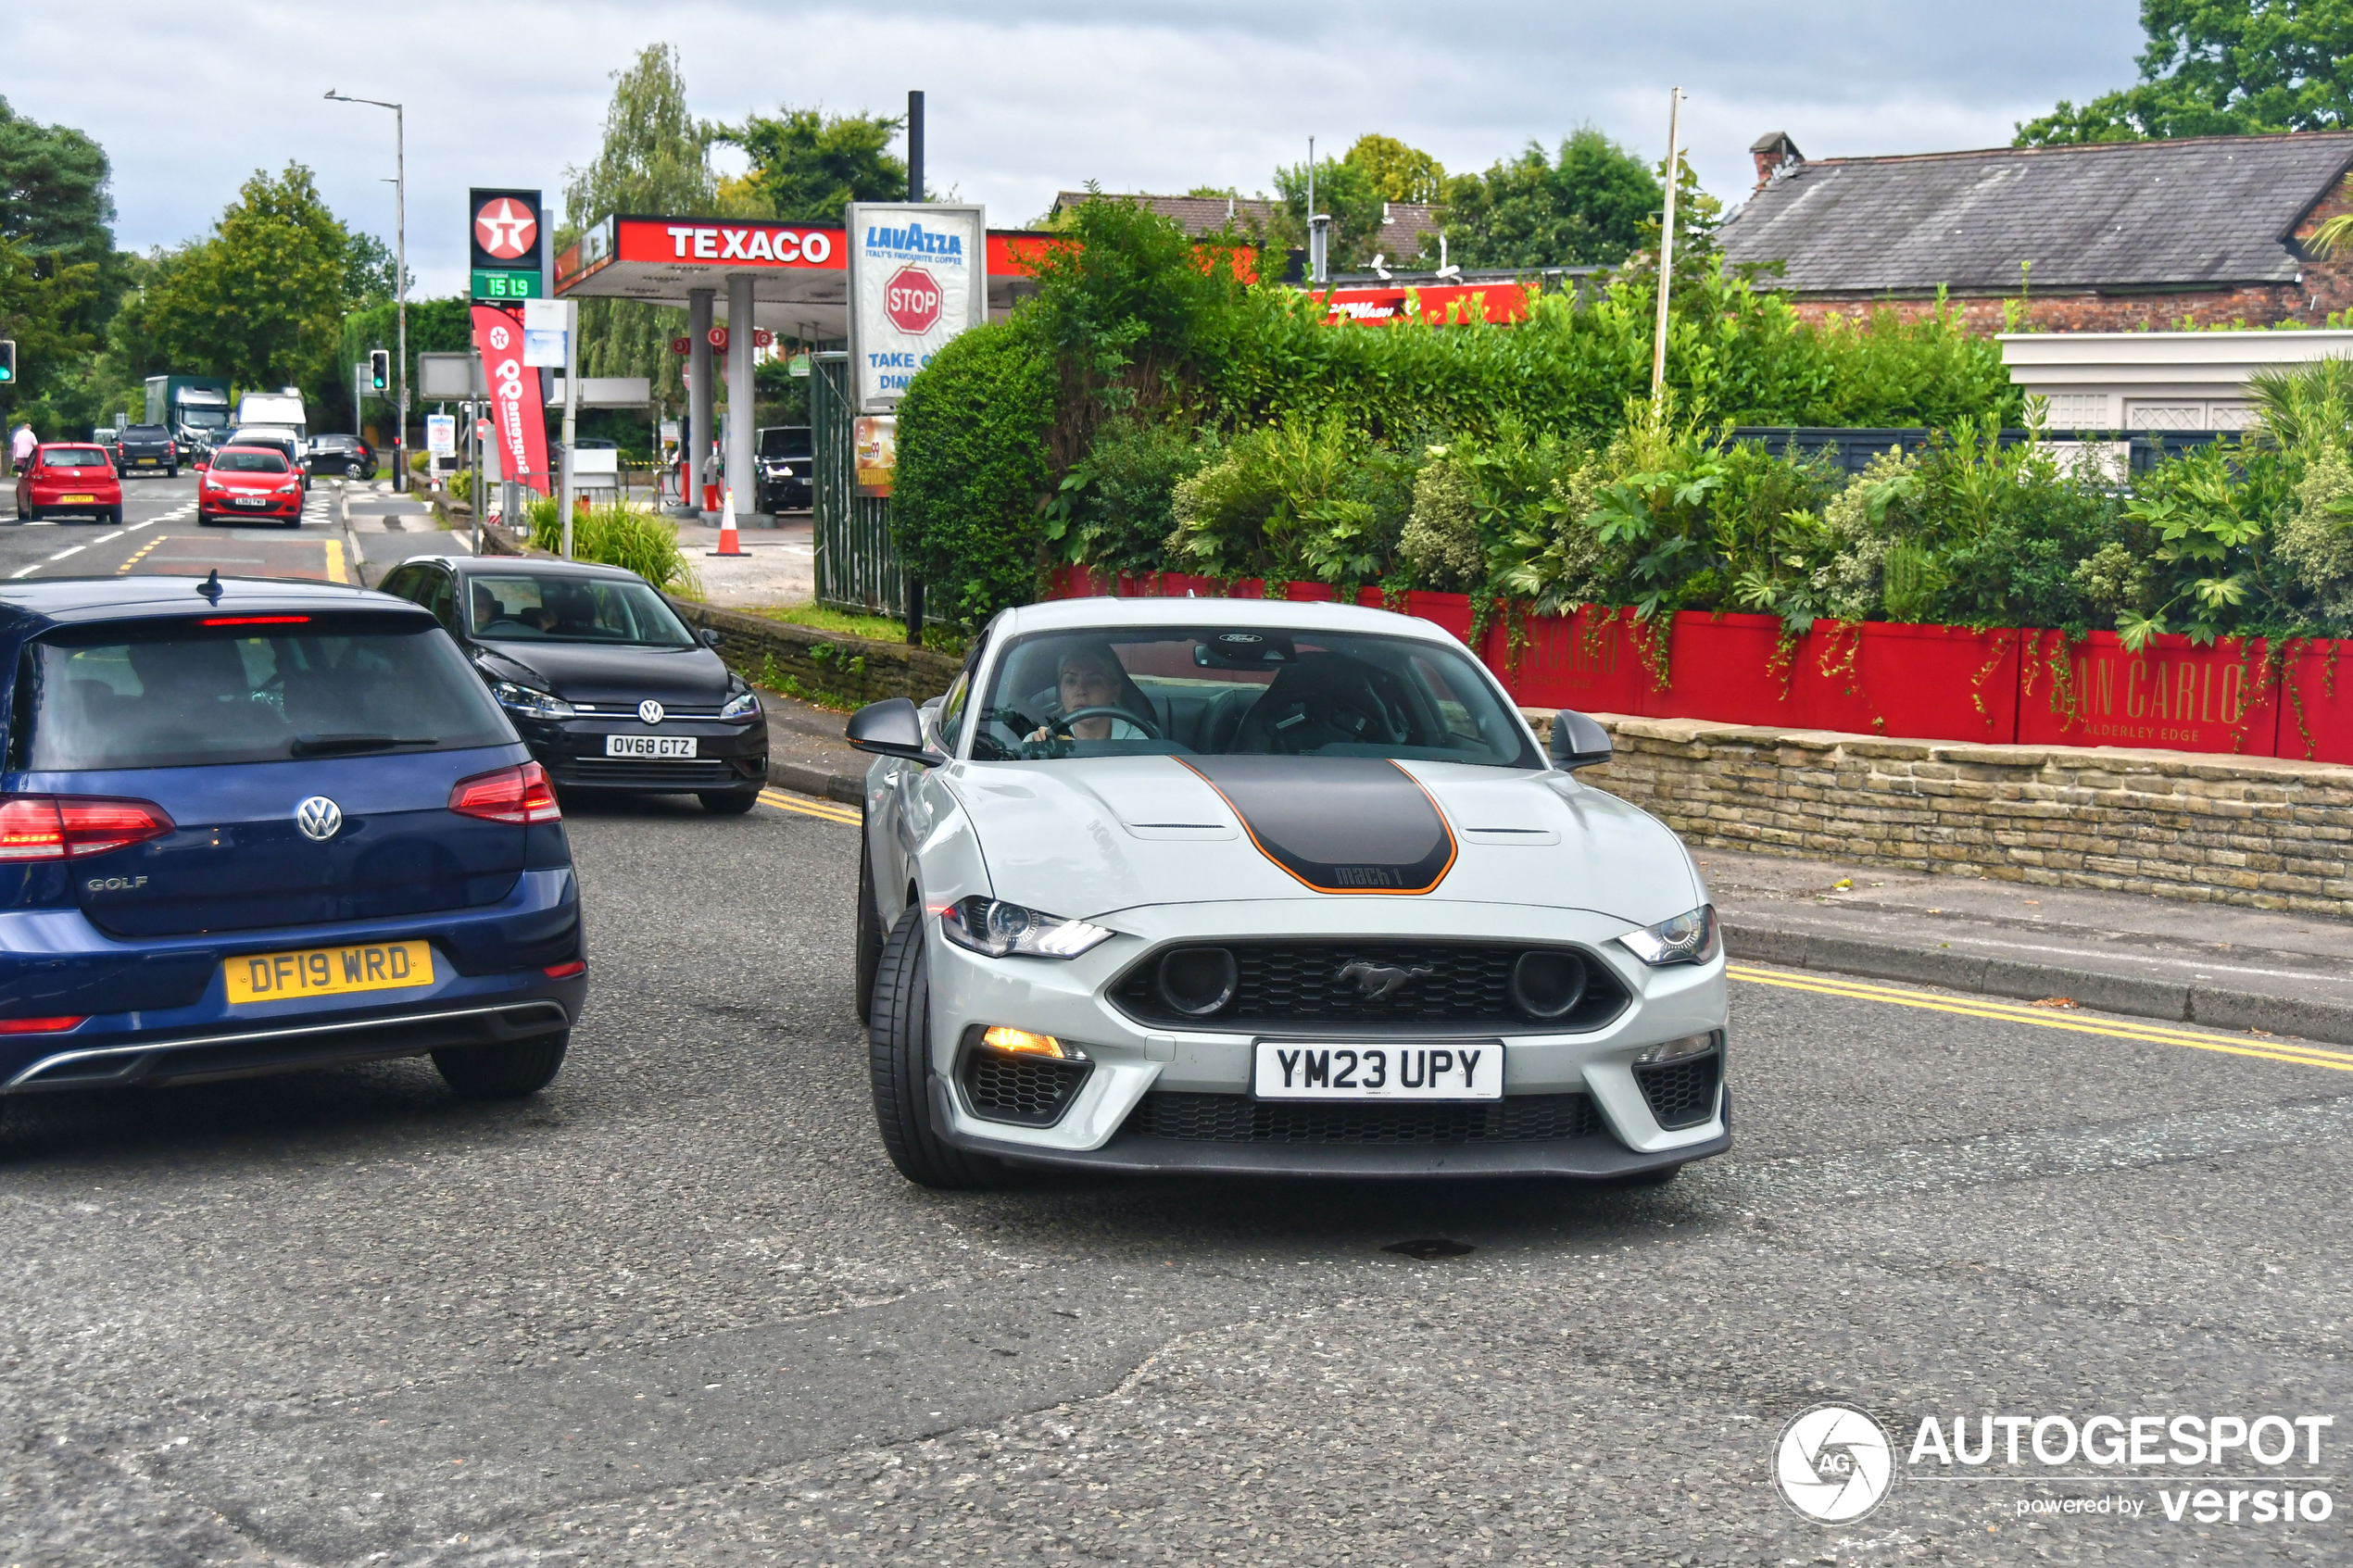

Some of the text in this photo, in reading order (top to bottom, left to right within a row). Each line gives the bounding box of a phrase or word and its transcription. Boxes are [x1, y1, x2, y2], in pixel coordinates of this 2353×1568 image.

[667, 227, 832, 263] TEXACO
[866, 223, 963, 256] LAVAZZA
[865, 249, 963, 266] ITALY'S FAVOURITE COFFEE
[890, 287, 937, 314] STOP
[869, 353, 914, 369] TAKE
[1227, 633, 1255, 642] Ford
[2126, 658, 2244, 724] CARLO
[2084, 723, 2199, 742] ALDERLEY EDGE
[613, 738, 689, 755] OV68 GTZ
[88, 875, 148, 892] GOLF
[248, 946, 410, 994] DF19 WRD
[1276, 1048, 1481, 1088] YM23 UPY
